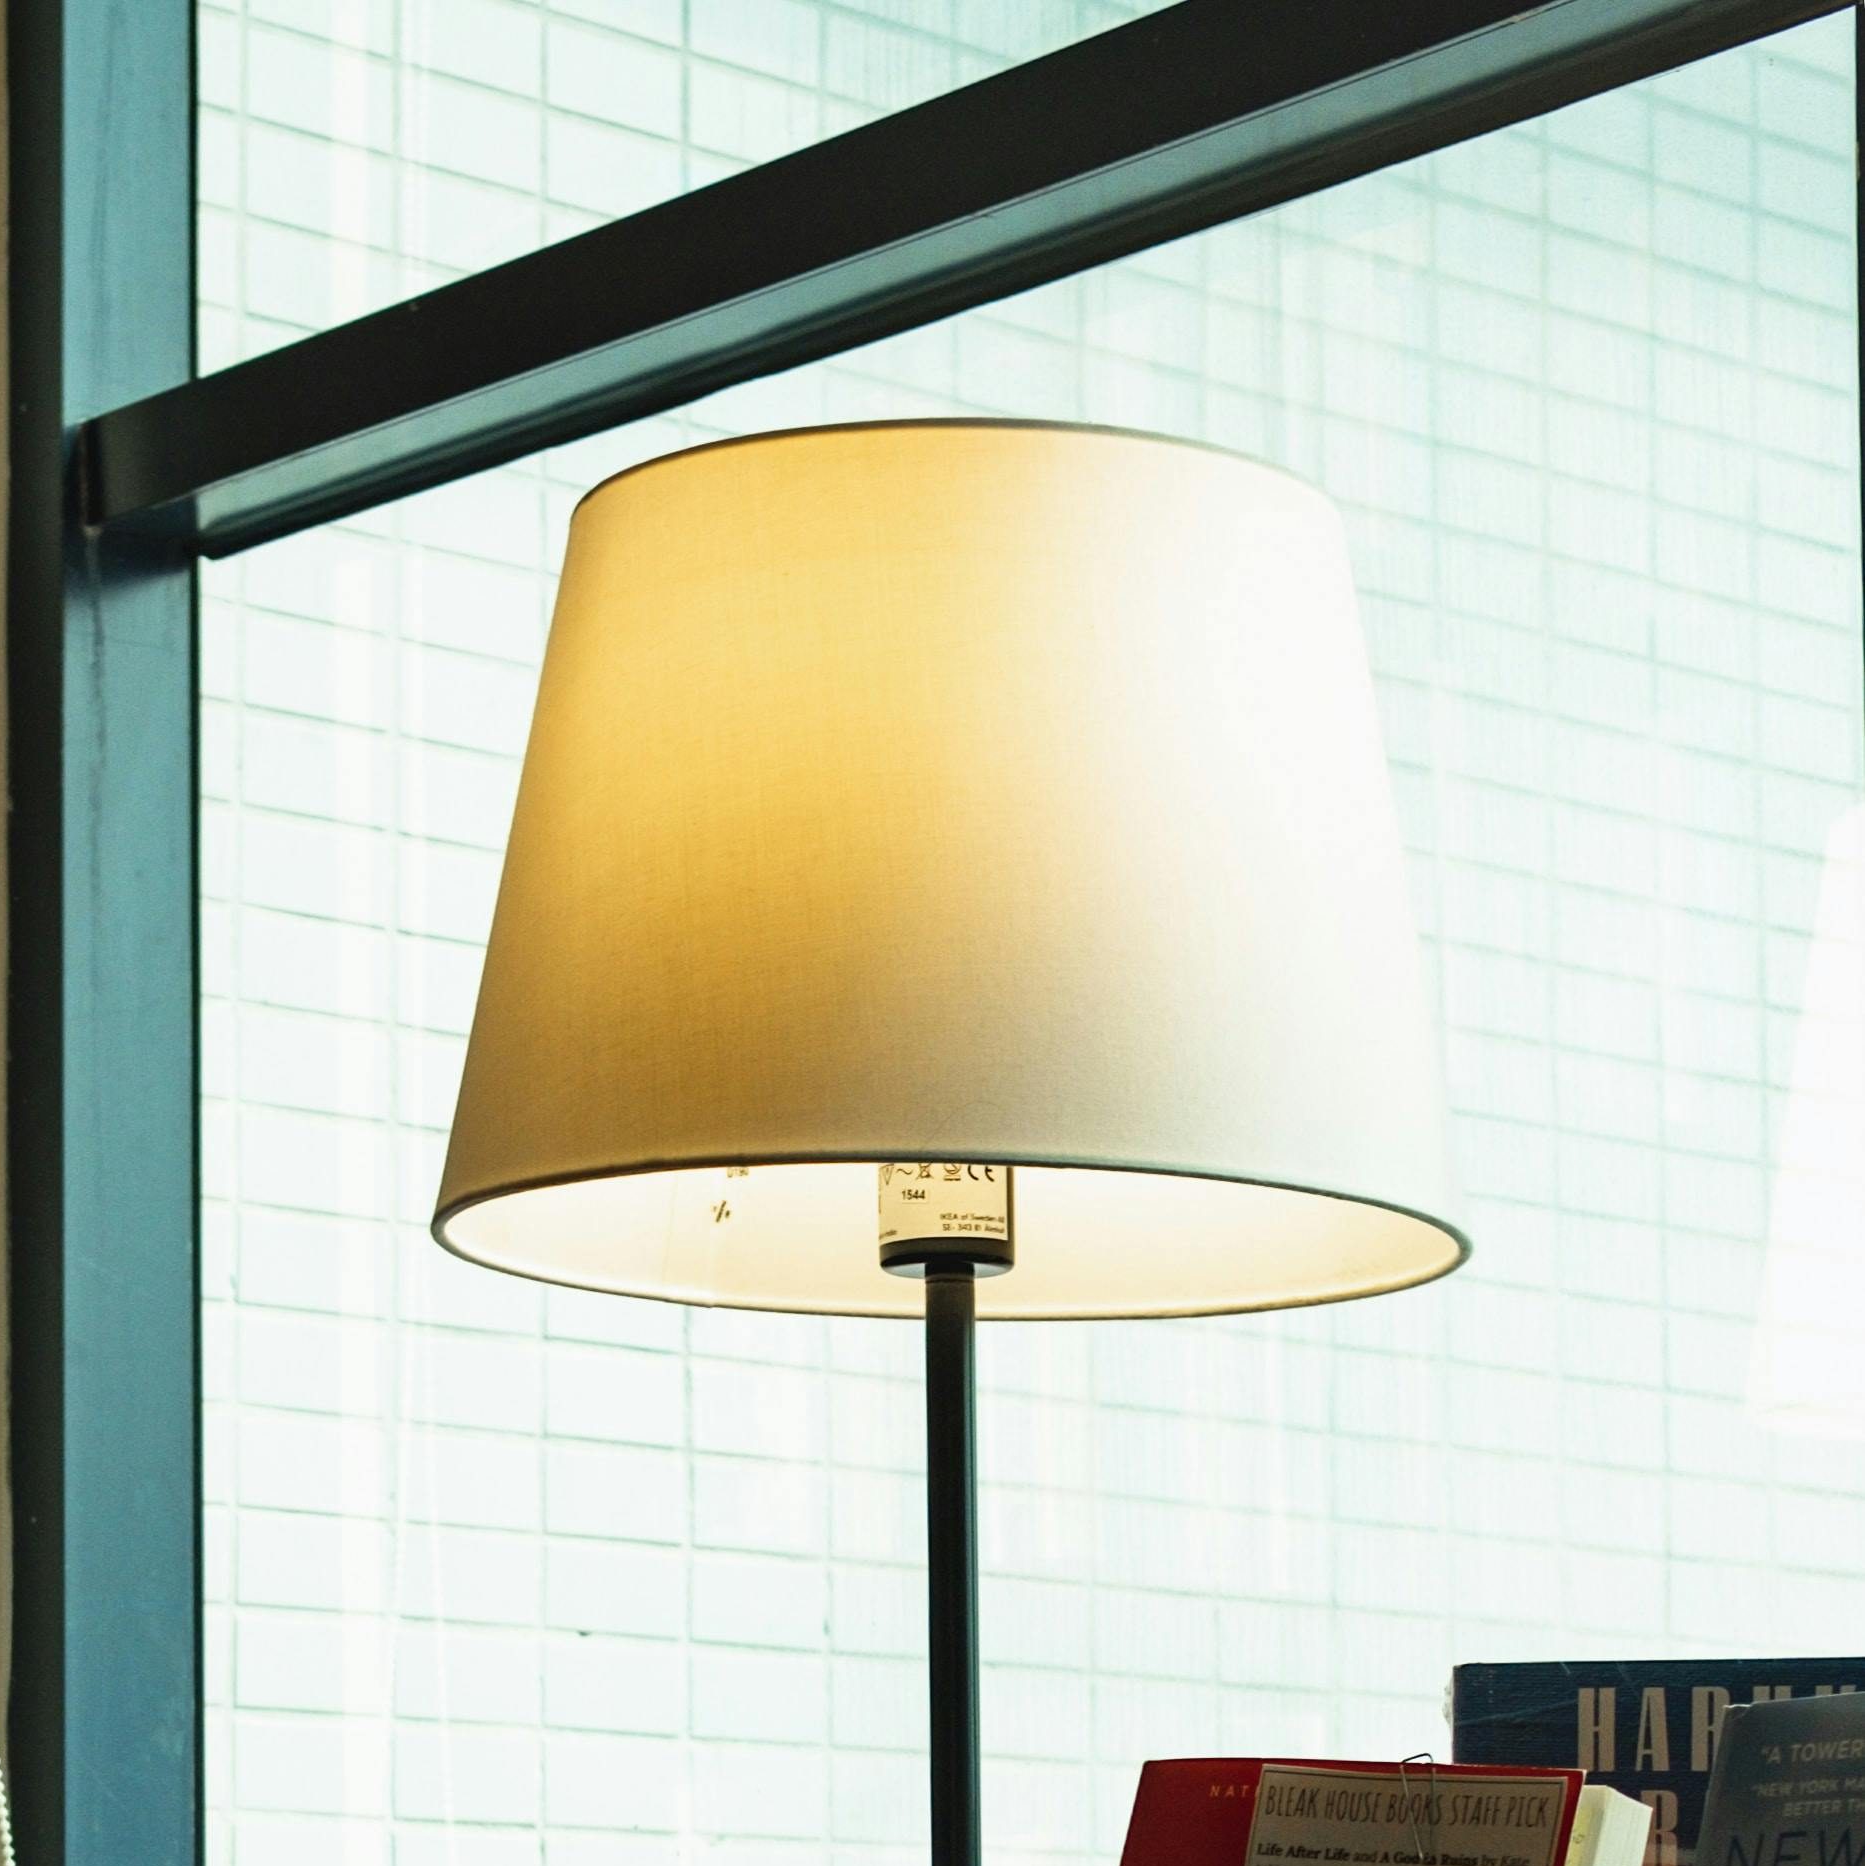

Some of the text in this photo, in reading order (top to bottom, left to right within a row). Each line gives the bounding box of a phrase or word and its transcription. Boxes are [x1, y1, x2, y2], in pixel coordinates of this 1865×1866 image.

[901, 1189, 926, 1200] 1544
[1265, 1785, 1548, 1828] BLEAK HOUSE BOOKS STAFF PICK
[1257, 1844, 1281, 1858] Life
[1285, 1846, 1320, 1861] After
[1325, 1849, 1349, 1862] Life
[1354, 1851, 1376, 1863] and
[1380, 1852, 1389, 1863] A
[1394, 1852, 1417, 1864] God
[1441, 1855, 1477, 1866] Ruins
